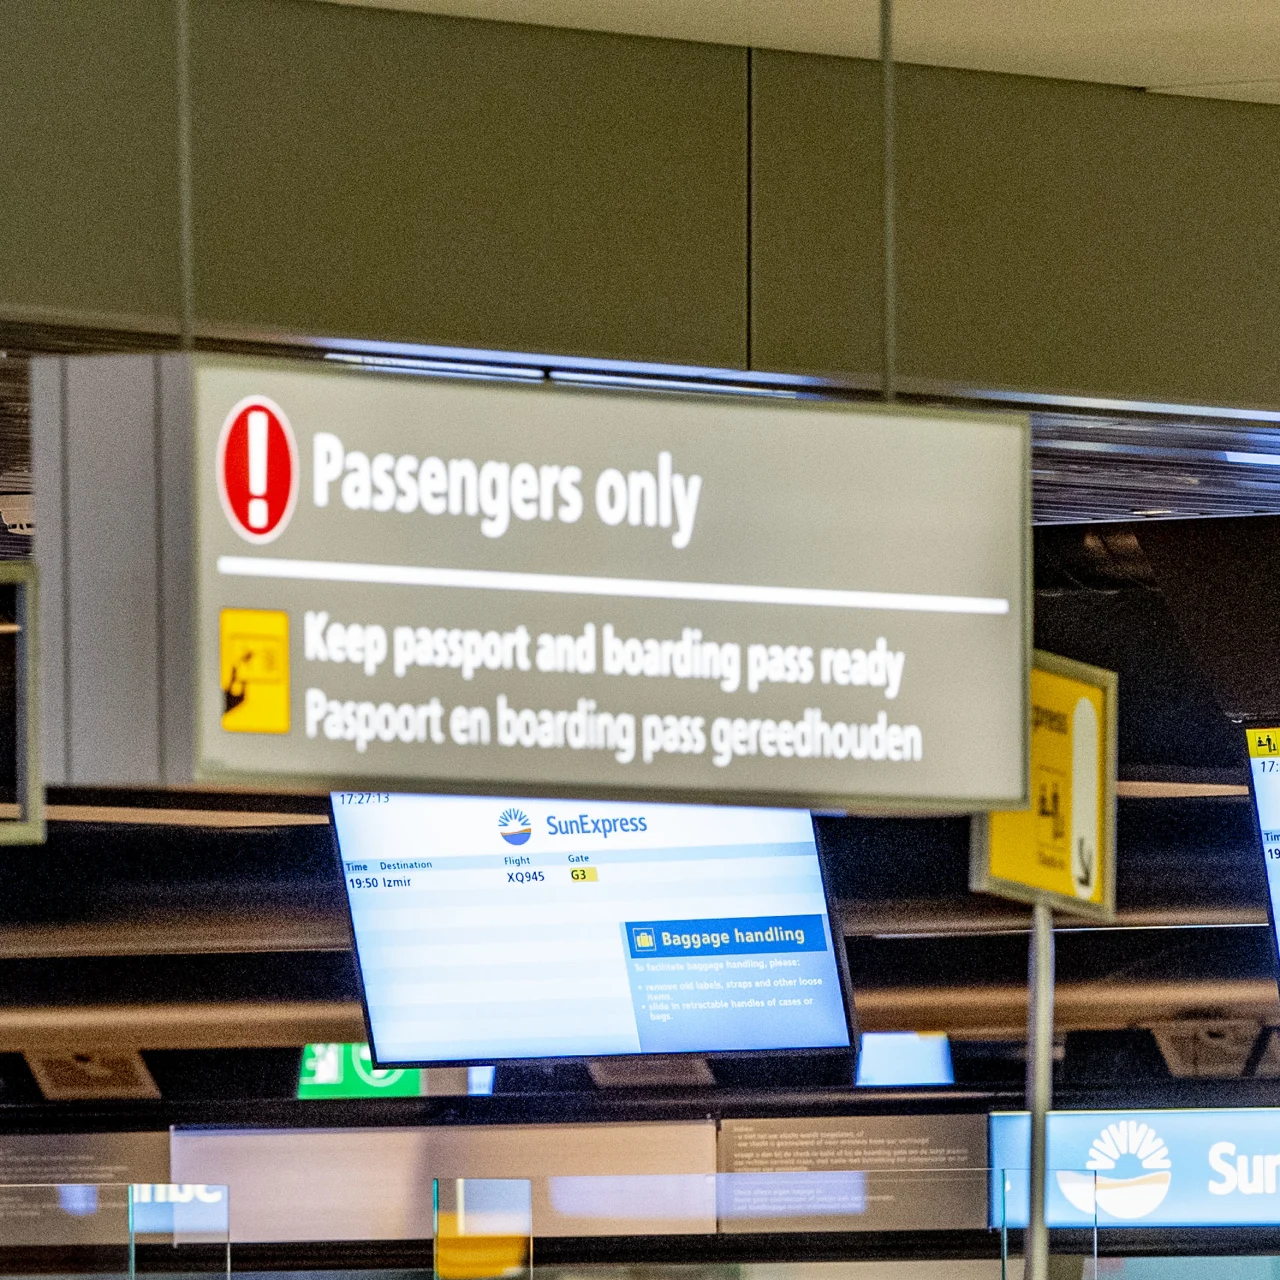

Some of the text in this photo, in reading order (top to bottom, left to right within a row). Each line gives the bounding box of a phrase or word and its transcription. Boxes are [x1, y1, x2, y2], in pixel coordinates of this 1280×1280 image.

[313, 429, 702, 549] Passengers only
[304, 611, 906, 699] Keep passport and boarding pass ready
[305, 690, 923, 767] Paspoort en boarding pass gereedhouden
[339, 792, 390, 806] 17:27:13
[546, 814, 647, 838] SunExpress
[346, 854, 590, 872] Time Destination Flight Gate
[349, 869, 587, 889] 19:50 Izmir XQ945 G3
[661, 926, 805, 950] Baggage handling
